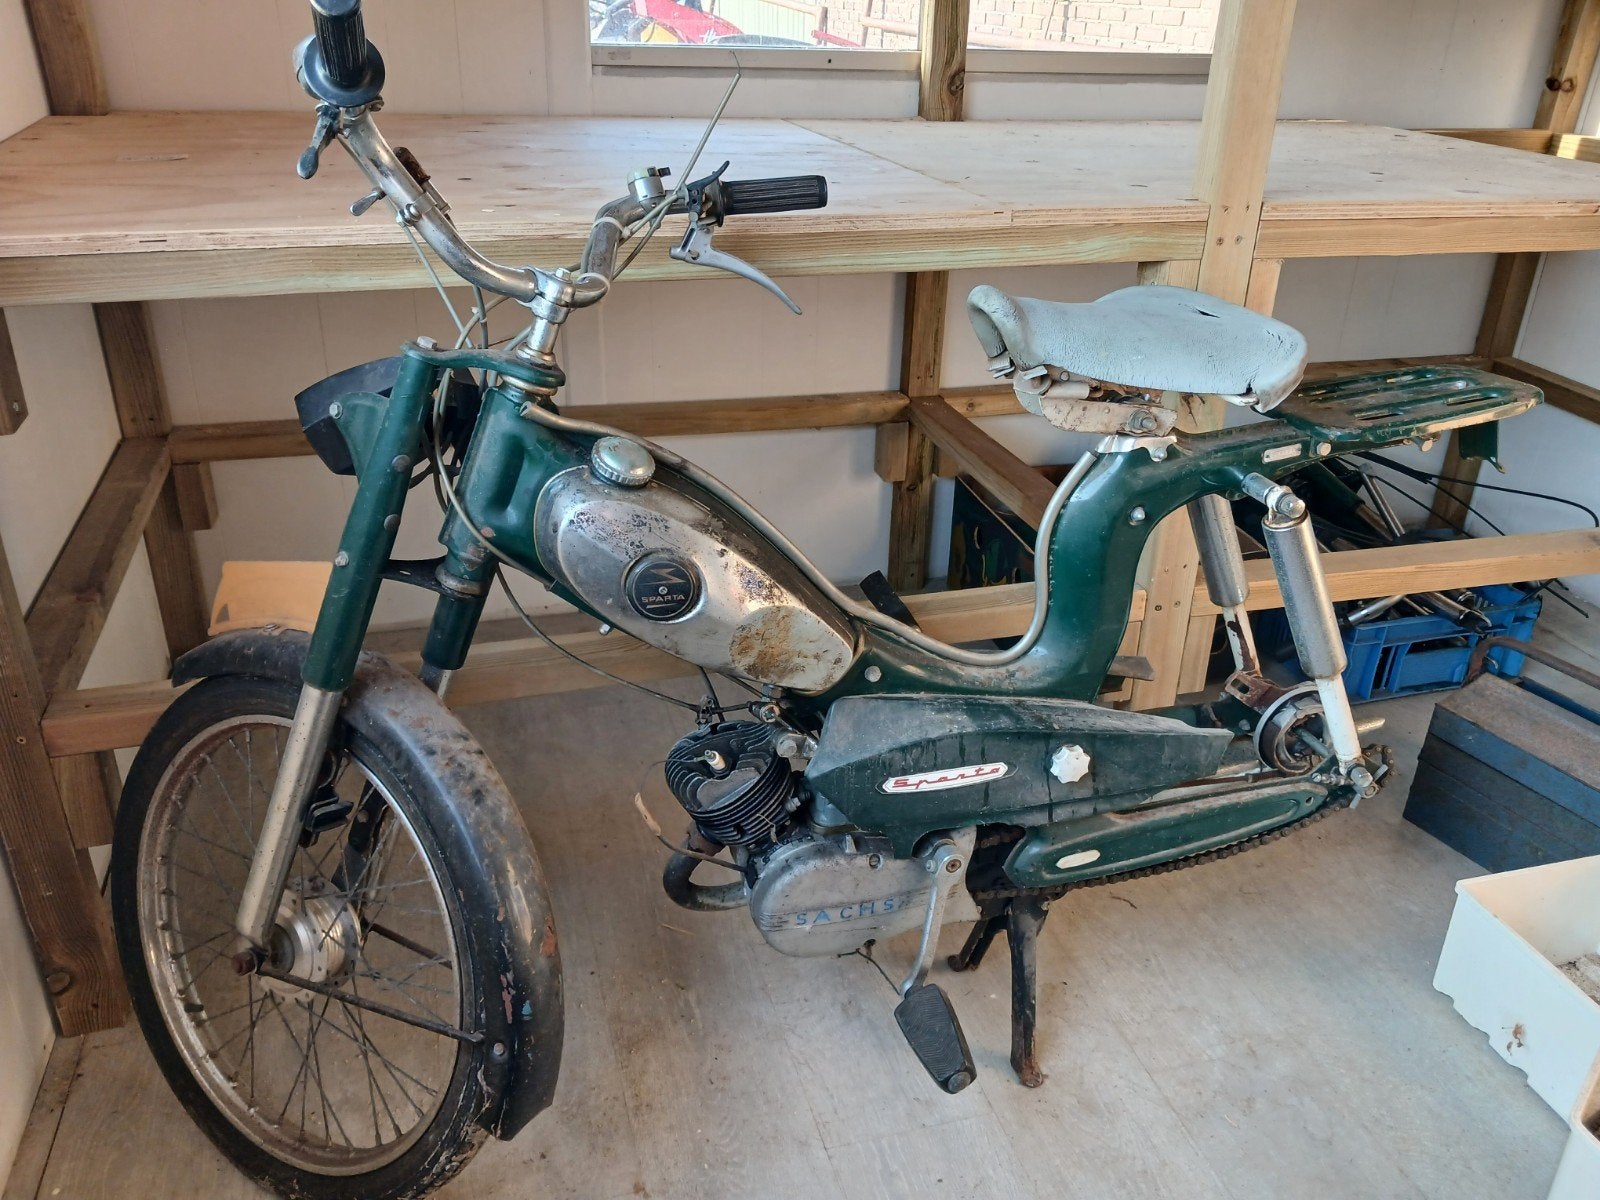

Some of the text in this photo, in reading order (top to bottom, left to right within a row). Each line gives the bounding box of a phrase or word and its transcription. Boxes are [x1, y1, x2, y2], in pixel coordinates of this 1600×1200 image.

[641, 594, 685, 603] SPARTA
[892, 766, 1001, 789] Sparta
[796, 897, 894, 926] SACHS
